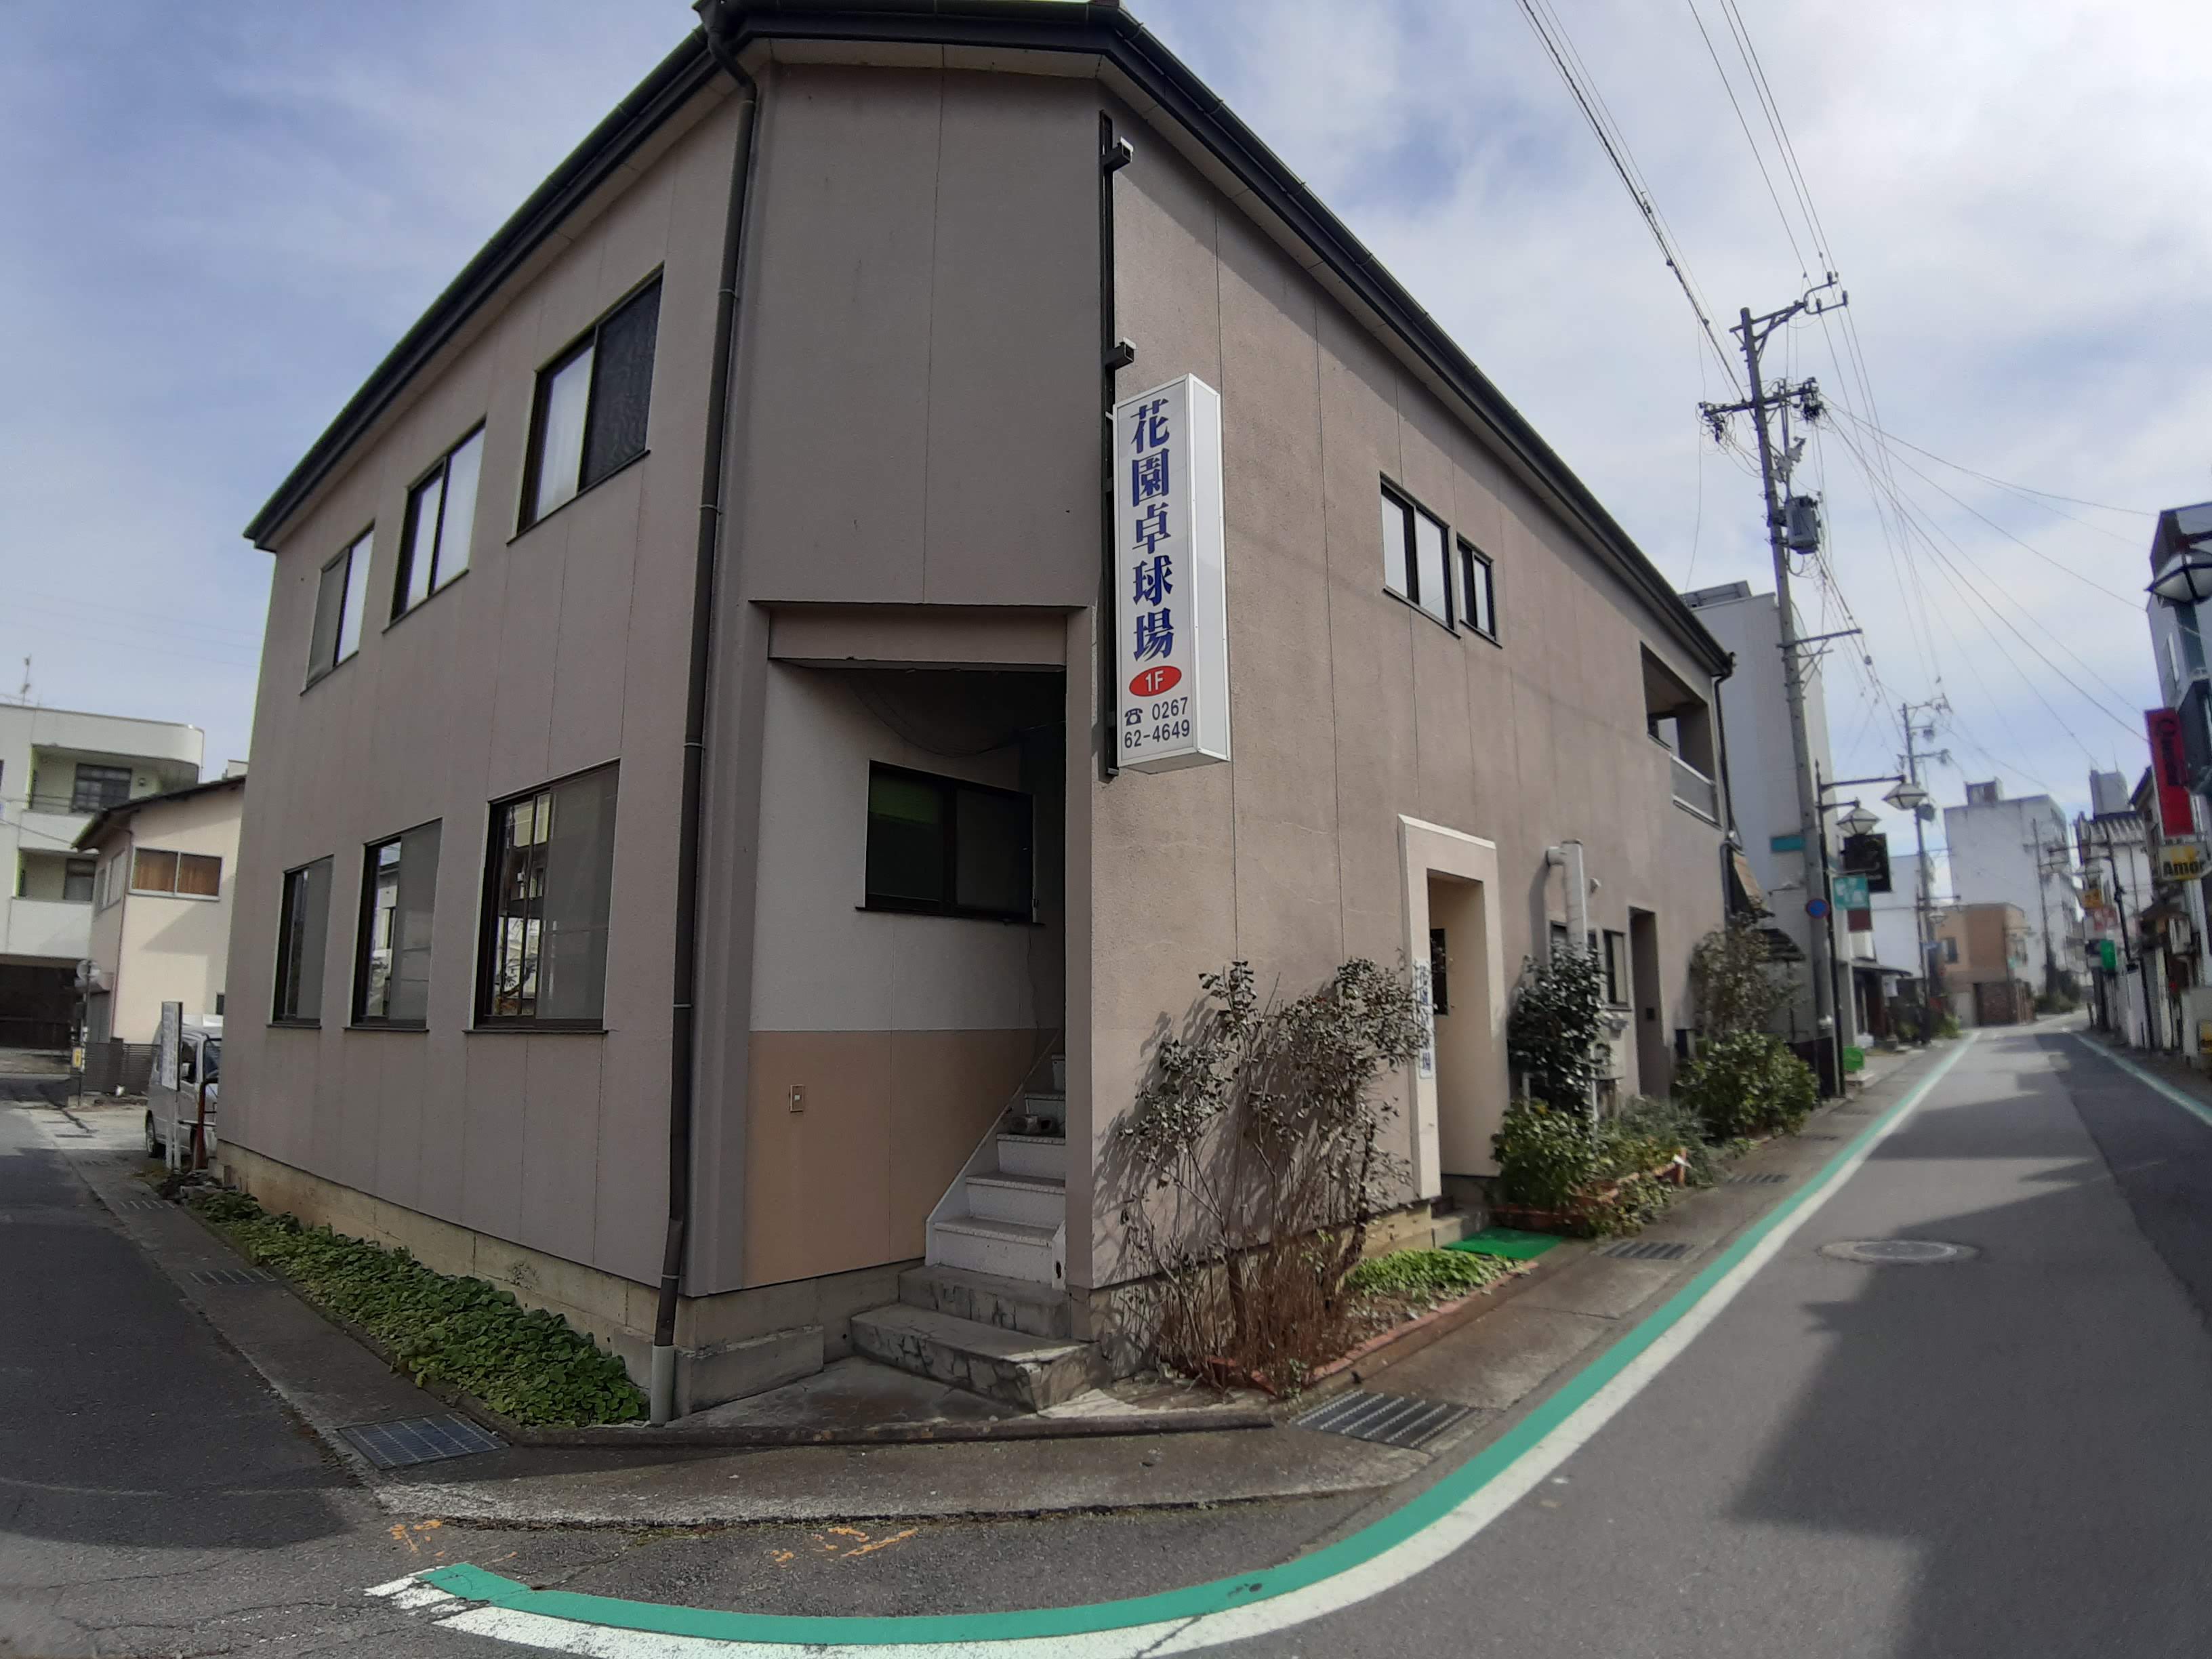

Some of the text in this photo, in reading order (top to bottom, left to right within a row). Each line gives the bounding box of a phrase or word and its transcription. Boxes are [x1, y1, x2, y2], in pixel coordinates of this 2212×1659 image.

[1130, 398, 1175, 663] 花園卓球場
[1145, 670, 1164, 693] 1F
[1151, 696, 1188, 721] 0267
[1124, 719, 1190, 749] 62-4649
